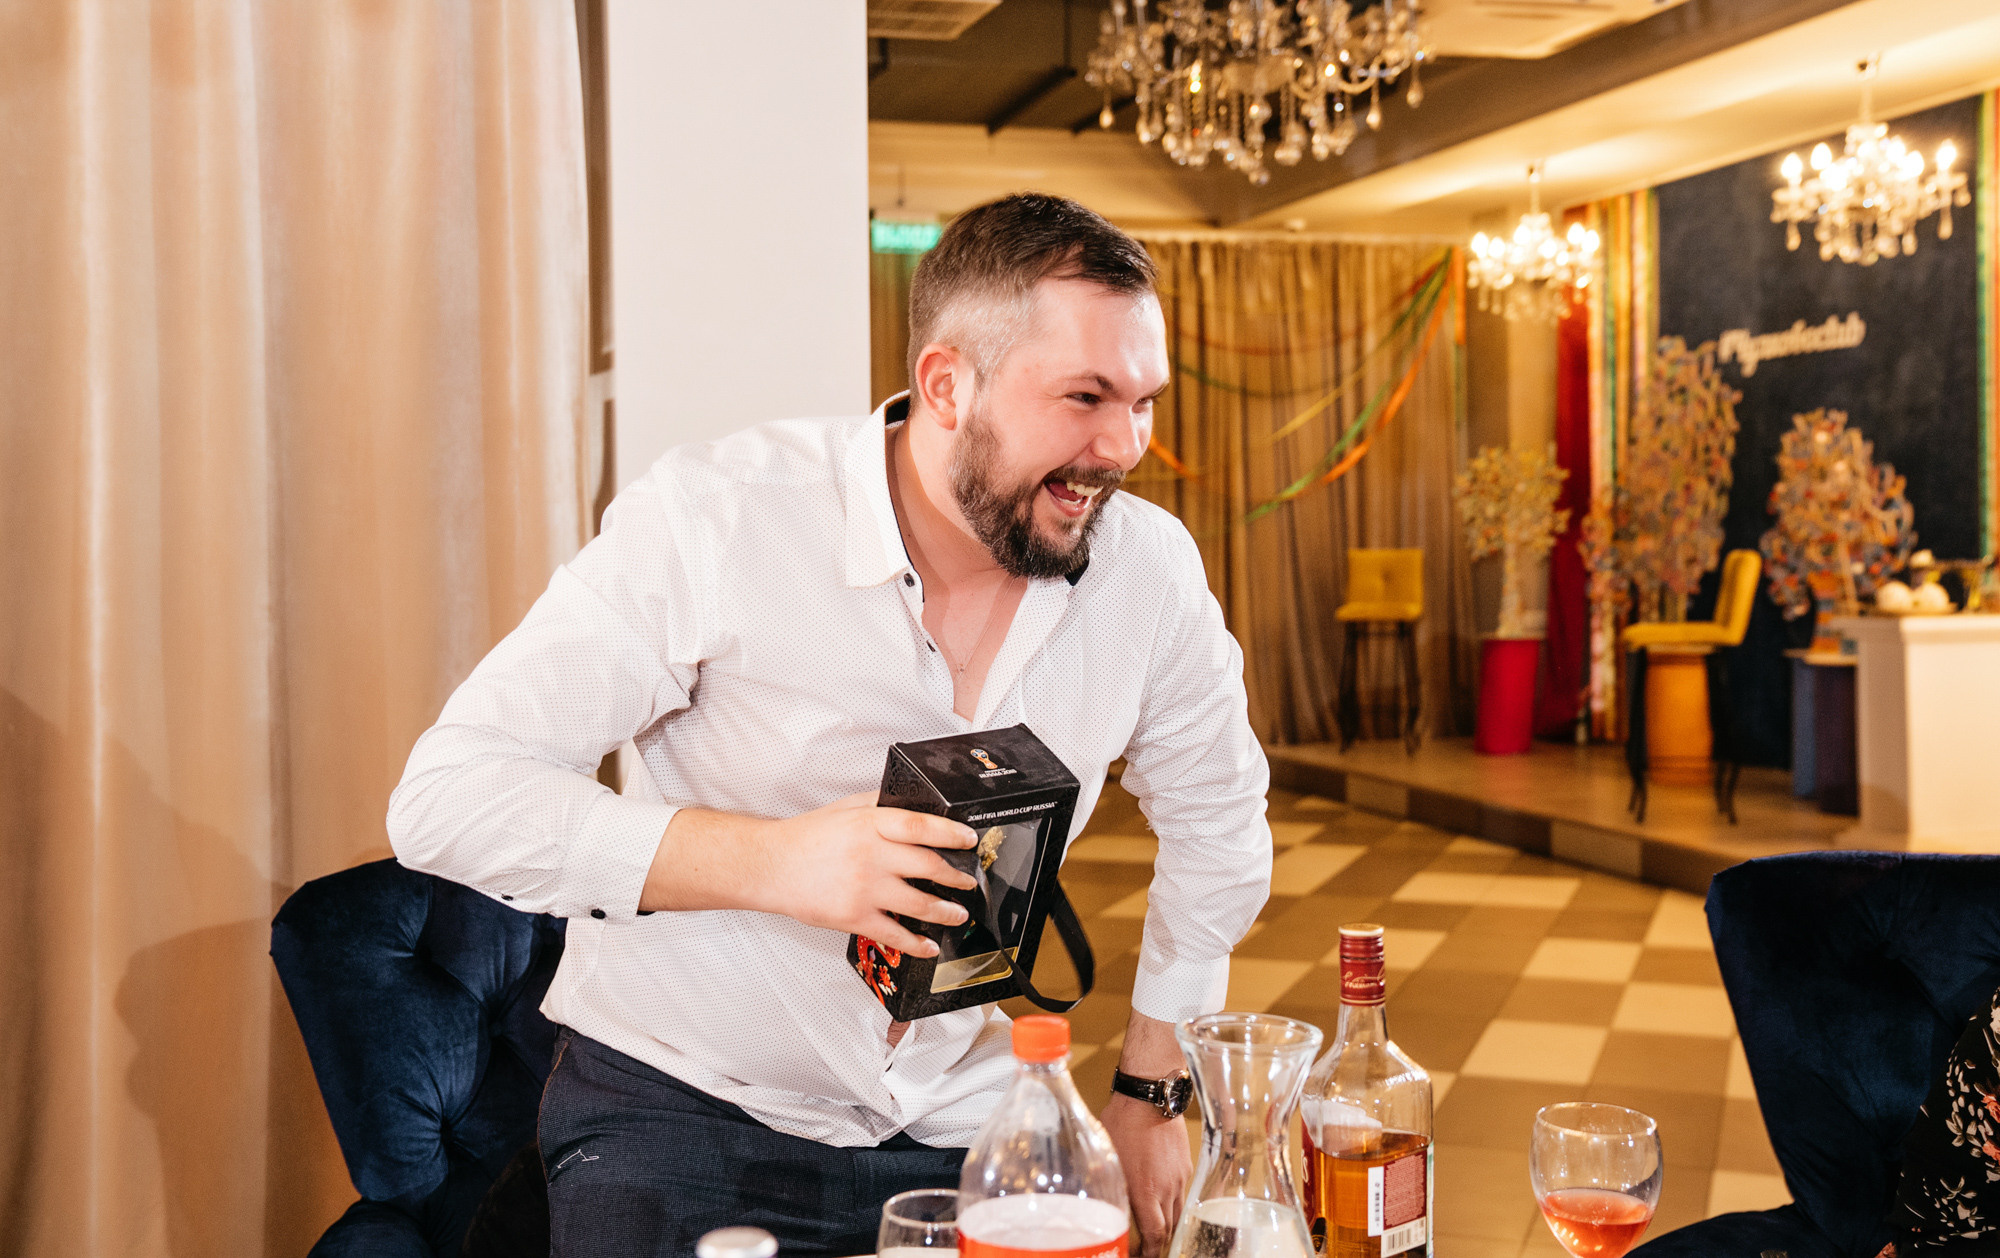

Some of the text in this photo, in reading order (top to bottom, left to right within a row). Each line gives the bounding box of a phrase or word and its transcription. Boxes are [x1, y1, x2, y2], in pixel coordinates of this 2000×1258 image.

[967, 813, 983, 822] 2018
[983, 811, 996, 820] FIFA
[996, 807, 1020, 818] WORLD
[1020, 805, 1033, 814] CUP
